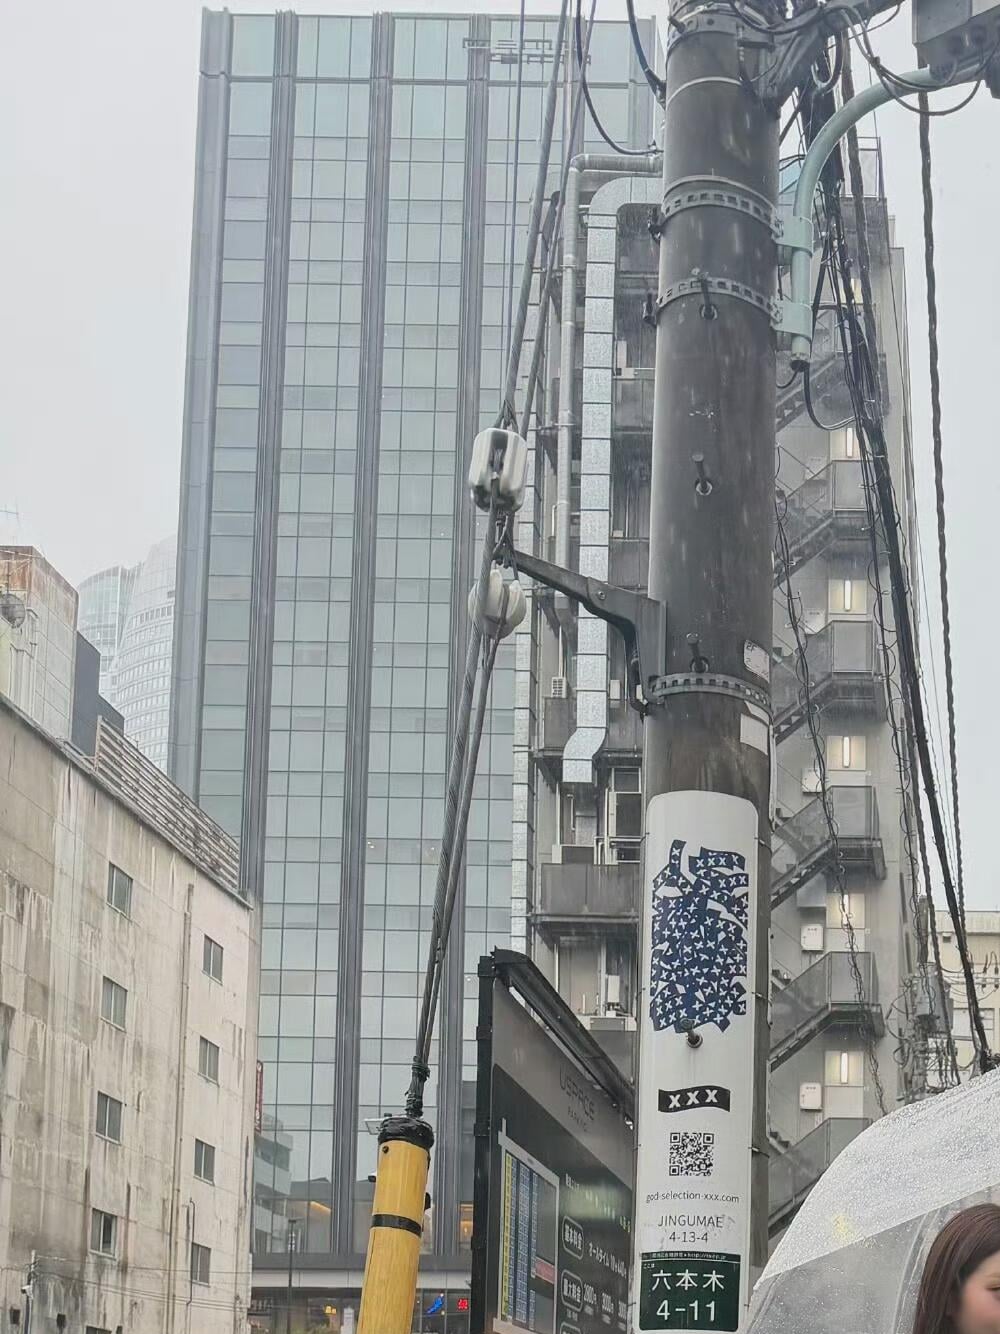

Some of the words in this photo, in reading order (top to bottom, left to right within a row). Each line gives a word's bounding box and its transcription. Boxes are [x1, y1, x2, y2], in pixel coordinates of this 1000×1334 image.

[646, 1190, 739, 1204] god-selection-xxx.com
[658, 1214, 724, 1229] JINGUMAE
[669, 1232, 709, 1244] 4-13-4
[651, 1268, 725, 1292] 六本木
[656, 1299, 716, 1323] 4-11
